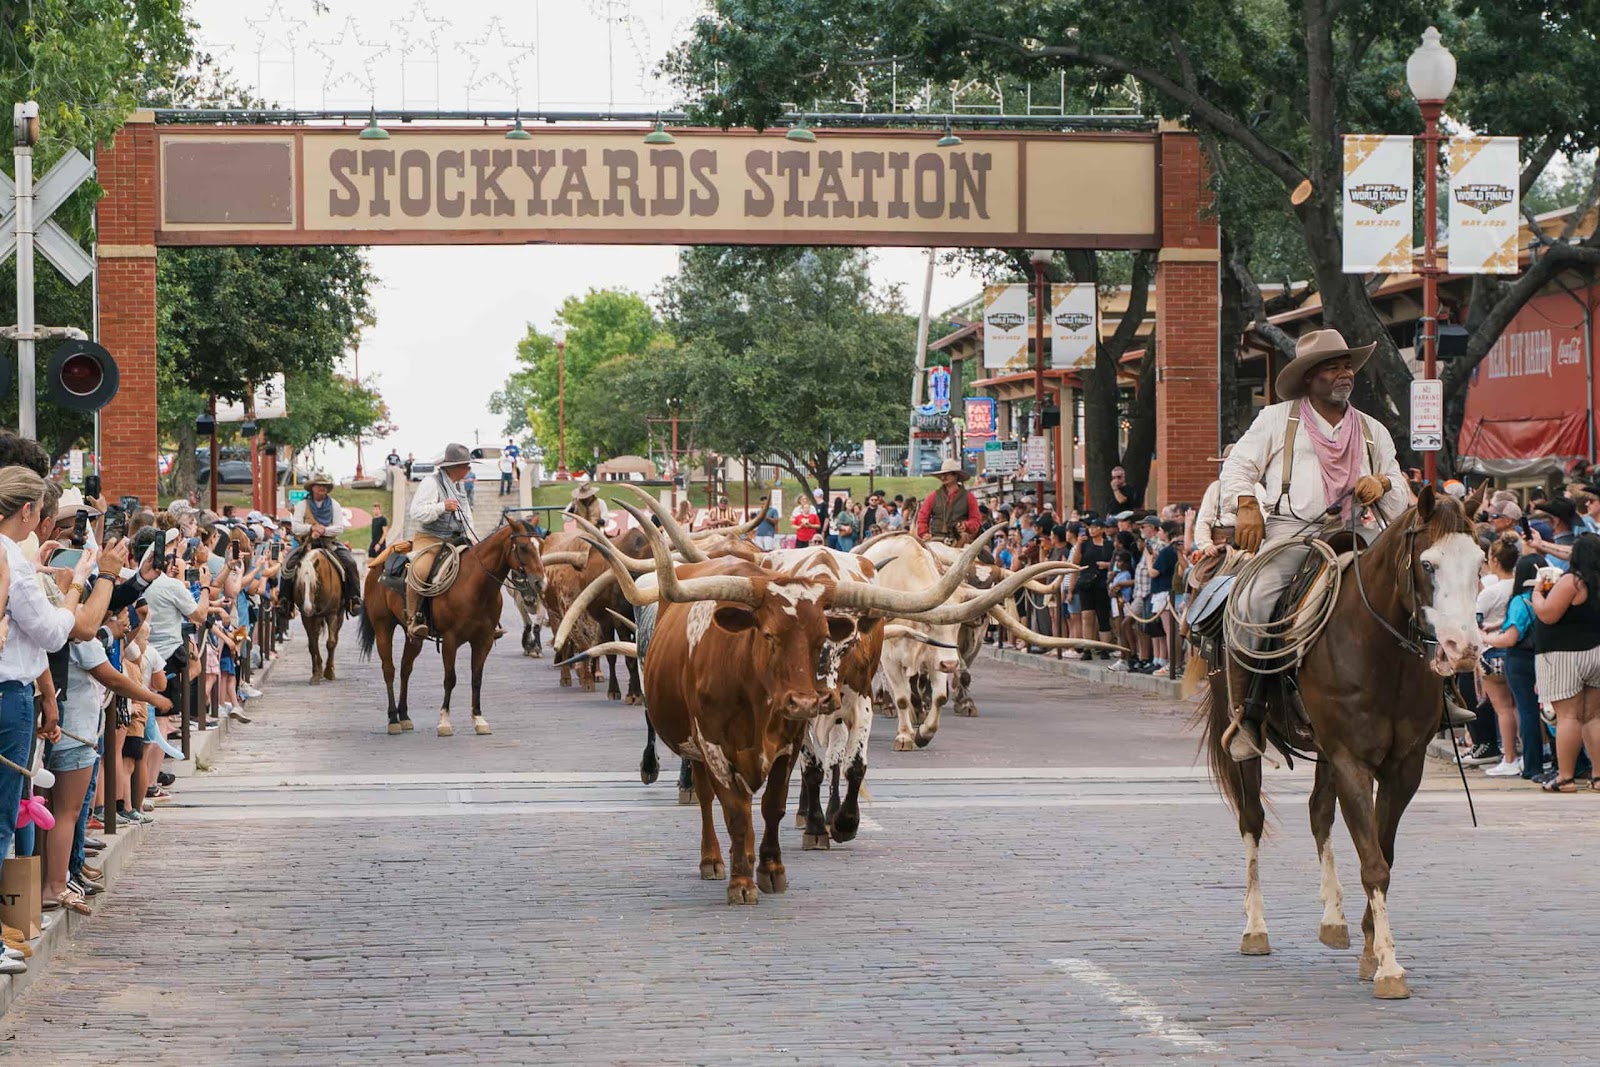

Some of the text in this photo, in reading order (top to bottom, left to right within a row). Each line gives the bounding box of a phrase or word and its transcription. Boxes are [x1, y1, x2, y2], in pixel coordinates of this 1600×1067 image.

[329, 148, 993, 220] STOCKYARDS STATION
[1351, 191, 1406, 201] WORLD FINALS
[1457, 191, 1512, 201] WORLD FINALS
[968, 404, 992, 414] FAT
[968, 421, 992, 430] DAY
